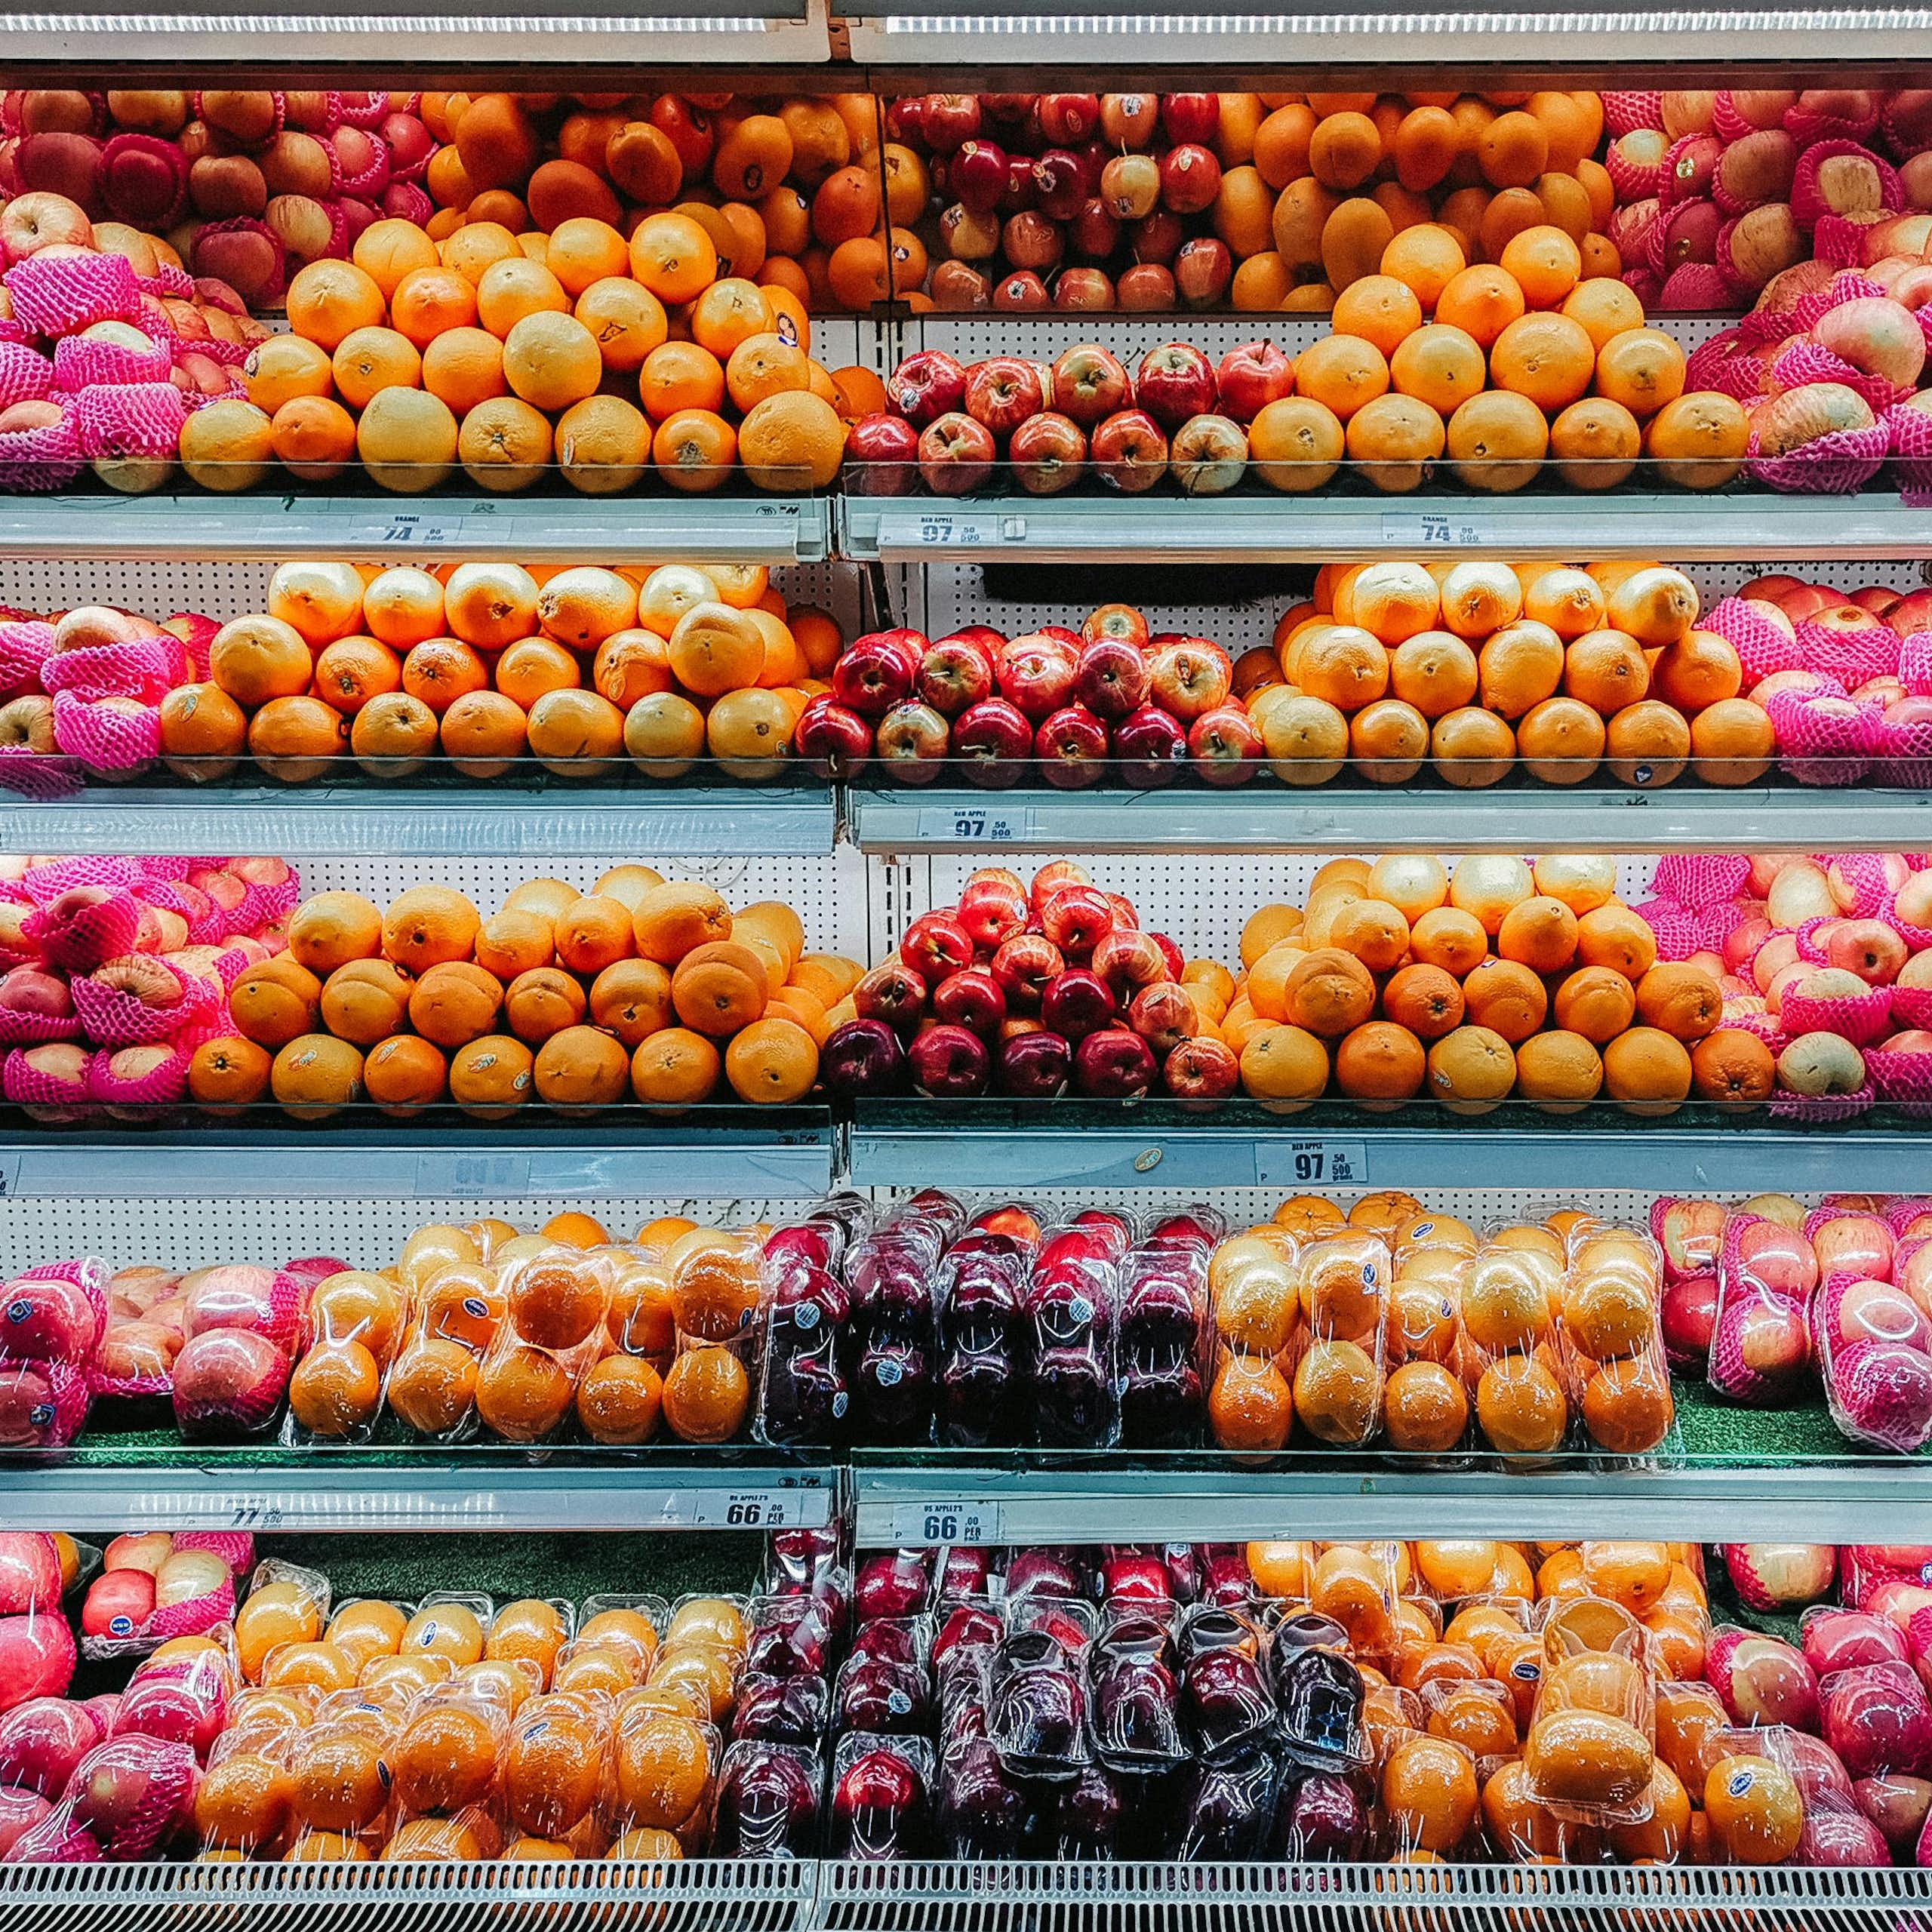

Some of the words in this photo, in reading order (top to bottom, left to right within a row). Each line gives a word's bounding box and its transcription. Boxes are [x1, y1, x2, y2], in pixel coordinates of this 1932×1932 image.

[922, 525, 952, 542] 97
[1421, 525, 1451, 541] 74
[955, 820, 985, 836] 97
[1304, 1142, 1323, 1151] APPLE
[1295, 1153, 1324, 1180] 97
[1332, 1164, 1351, 1175] 500
[1260, 1173, 1268, 1181] P
[231, 1508, 261, 1527] 77
[263, 1515, 283, 1524] 500
[727, 1504, 761, 1524] 66
[924, 1515, 957, 1540] 66
[965, 1517, 979, 1525] .00
[894, 1531, 903, 1539] P
[964, 1527, 981, 1537] PER
